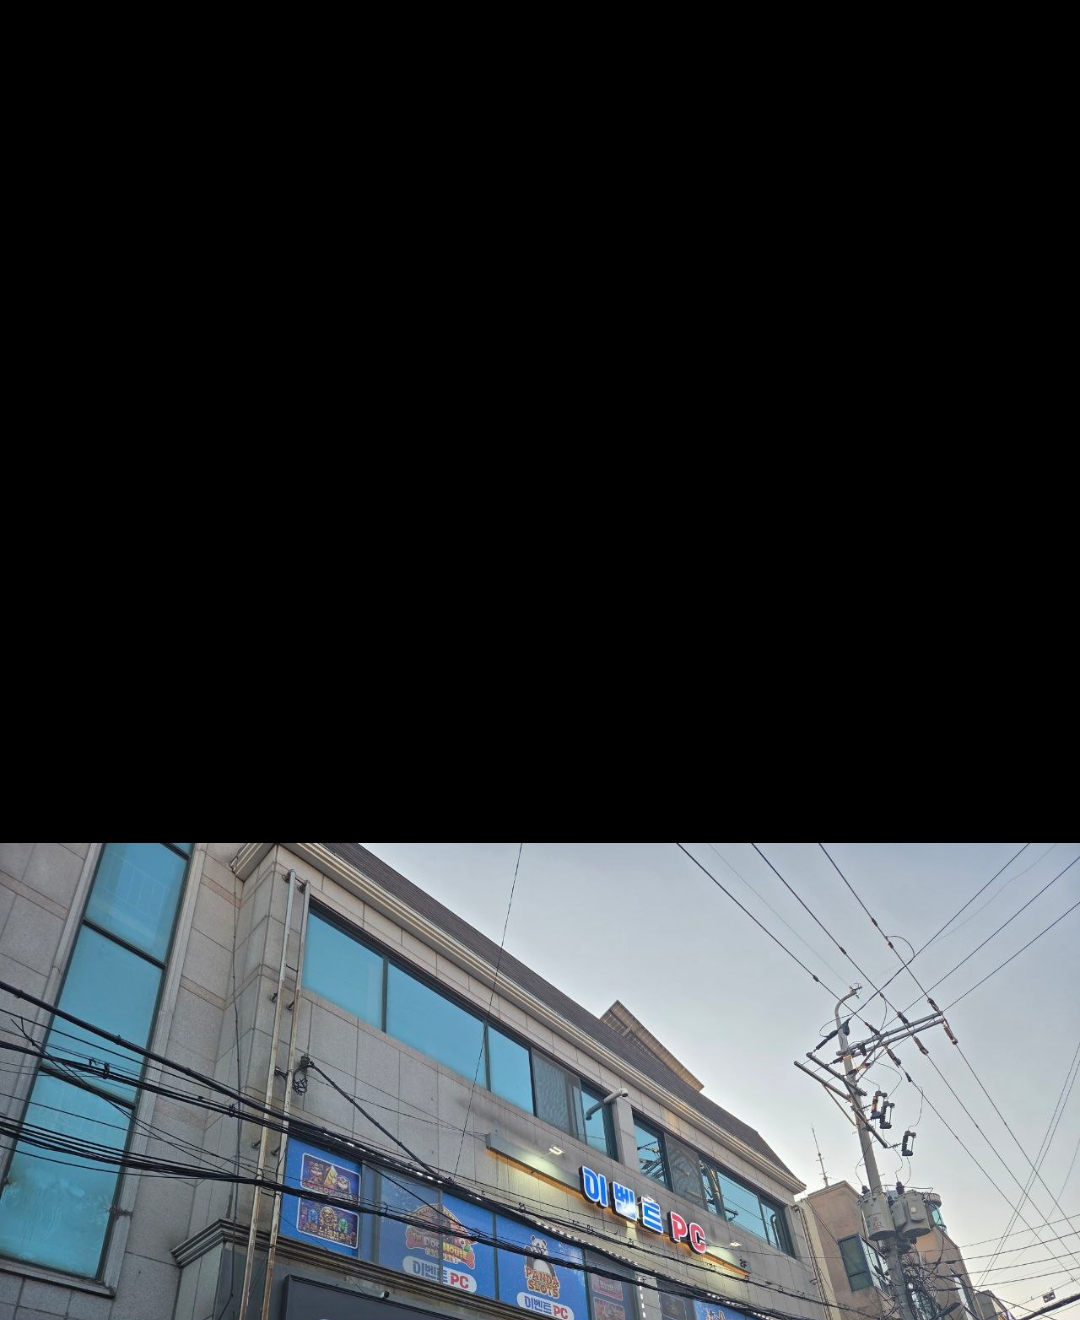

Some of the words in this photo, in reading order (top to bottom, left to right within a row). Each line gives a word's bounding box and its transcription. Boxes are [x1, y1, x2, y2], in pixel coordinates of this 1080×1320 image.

[582, 1165, 663, 1233] 이벤트
[670, 1210, 707, 1254] PC
[450, 1272, 469, 1289] PC
[526, 1267, 559, 1287] PANDA
[528, 1282, 559, 1298] SLOTS
[524, 1296, 551, 1314] 이벤트
[553, 1305, 568, 1319] PC
